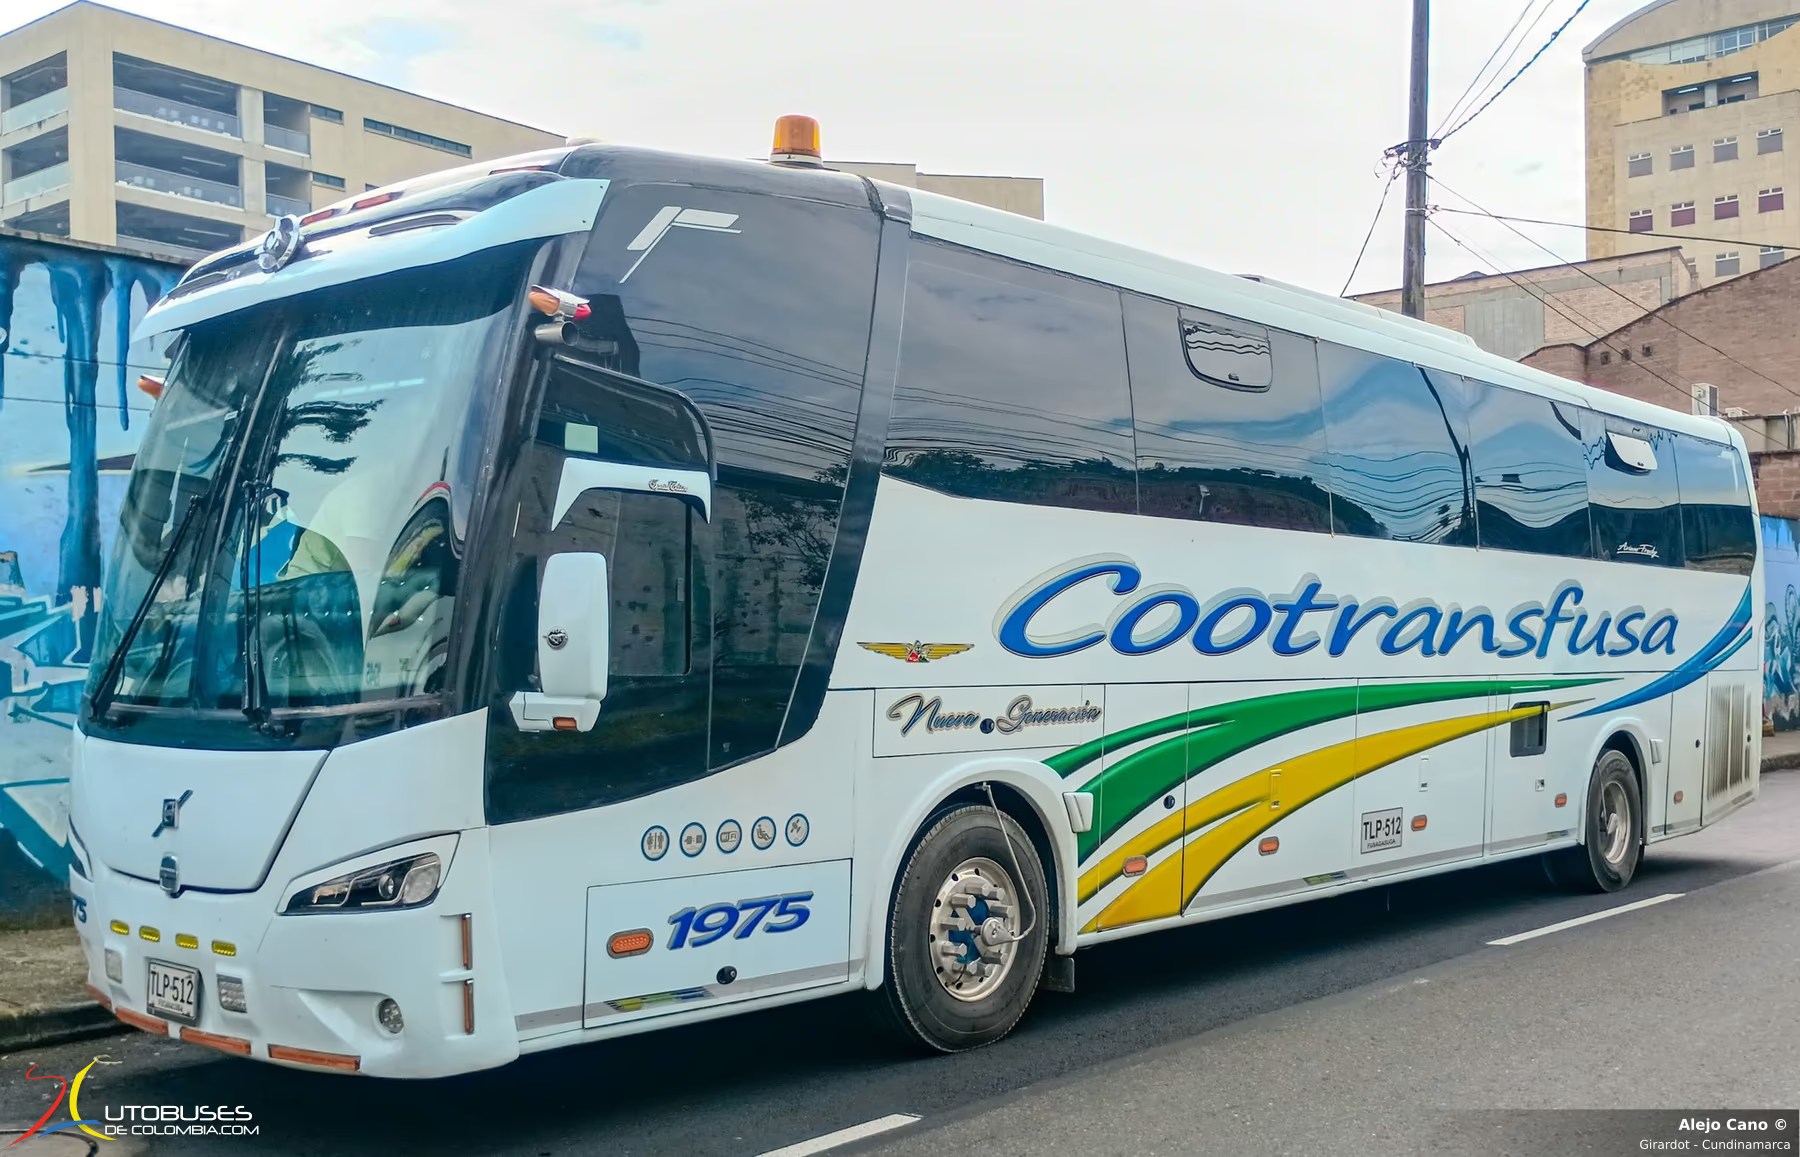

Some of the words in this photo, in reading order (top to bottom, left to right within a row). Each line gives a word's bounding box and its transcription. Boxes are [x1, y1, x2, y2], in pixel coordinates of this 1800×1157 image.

[993, 553, 1679, 659] Cootransfusa
[886, 693, 980, 737] Nueva
[995, 695, 1102, 735] Generación
[1363, 816, 1401, 840] TLP-512
[666, 890, 814, 951] 1975
[150, 970, 195, 1006] TLP-512
